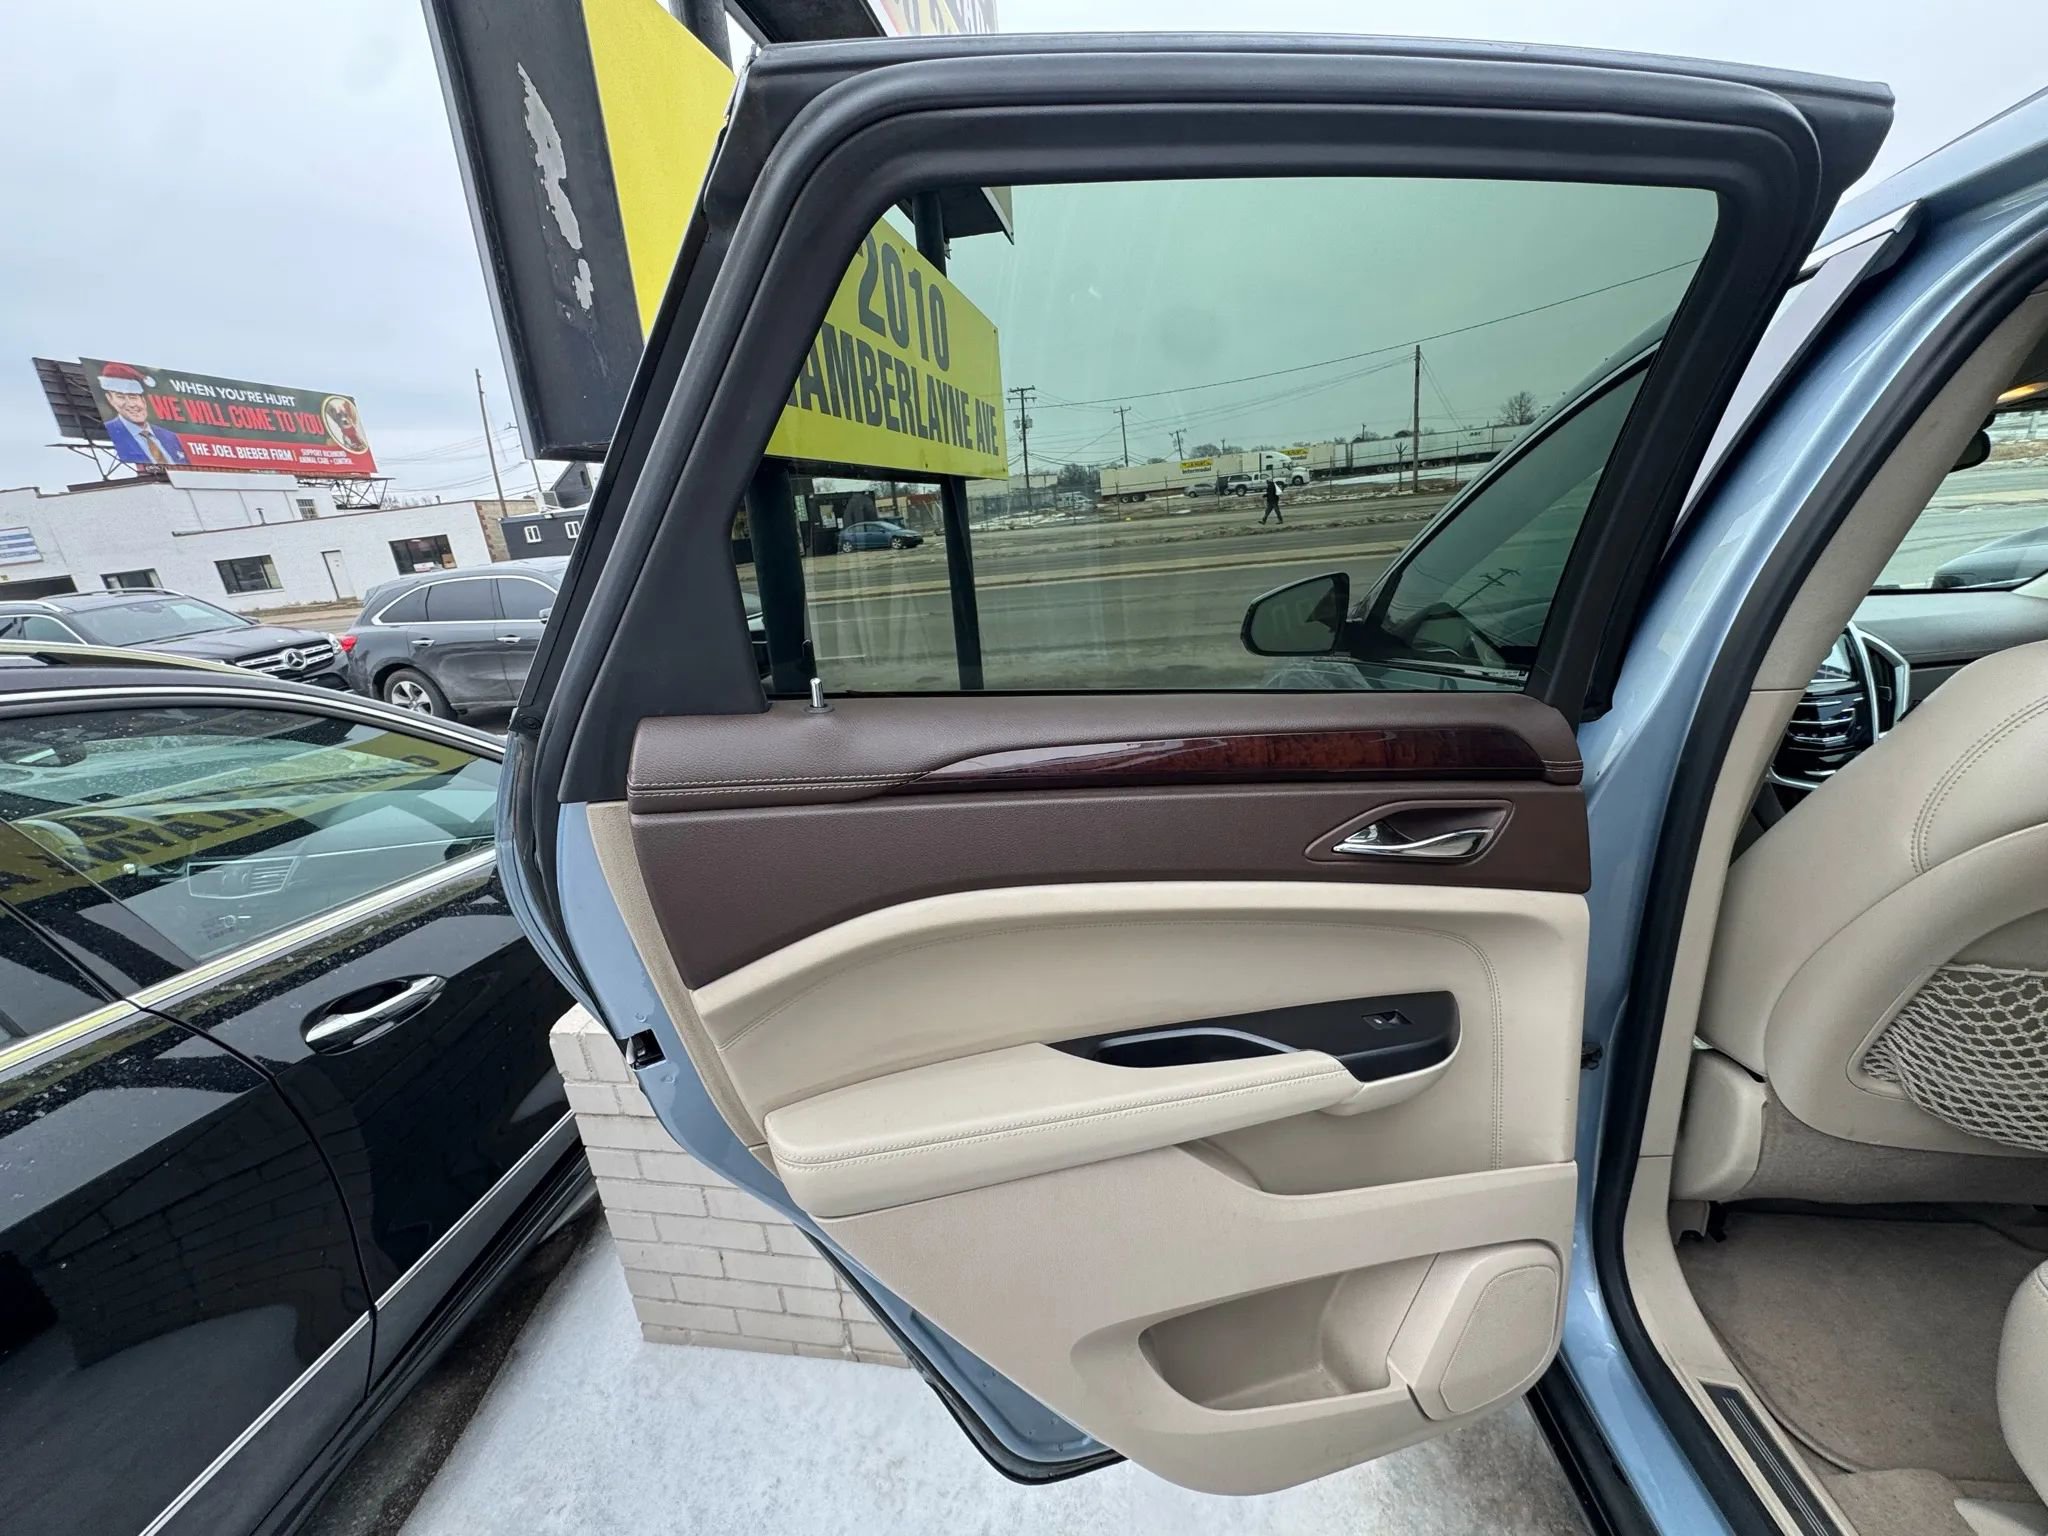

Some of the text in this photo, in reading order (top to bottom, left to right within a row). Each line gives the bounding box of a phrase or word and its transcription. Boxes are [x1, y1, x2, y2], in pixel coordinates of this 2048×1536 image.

[857, 231, 949, 372] 2010
[169, 379, 295, 407] WHEN YOU'RE HURT
[787, 320, 999, 457] AMBERLAYNE AVE
[148, 394, 325, 436] WE WILL COME TO YOU
[187, 442, 294, 461] THE JOEL BIEBER FIRM
